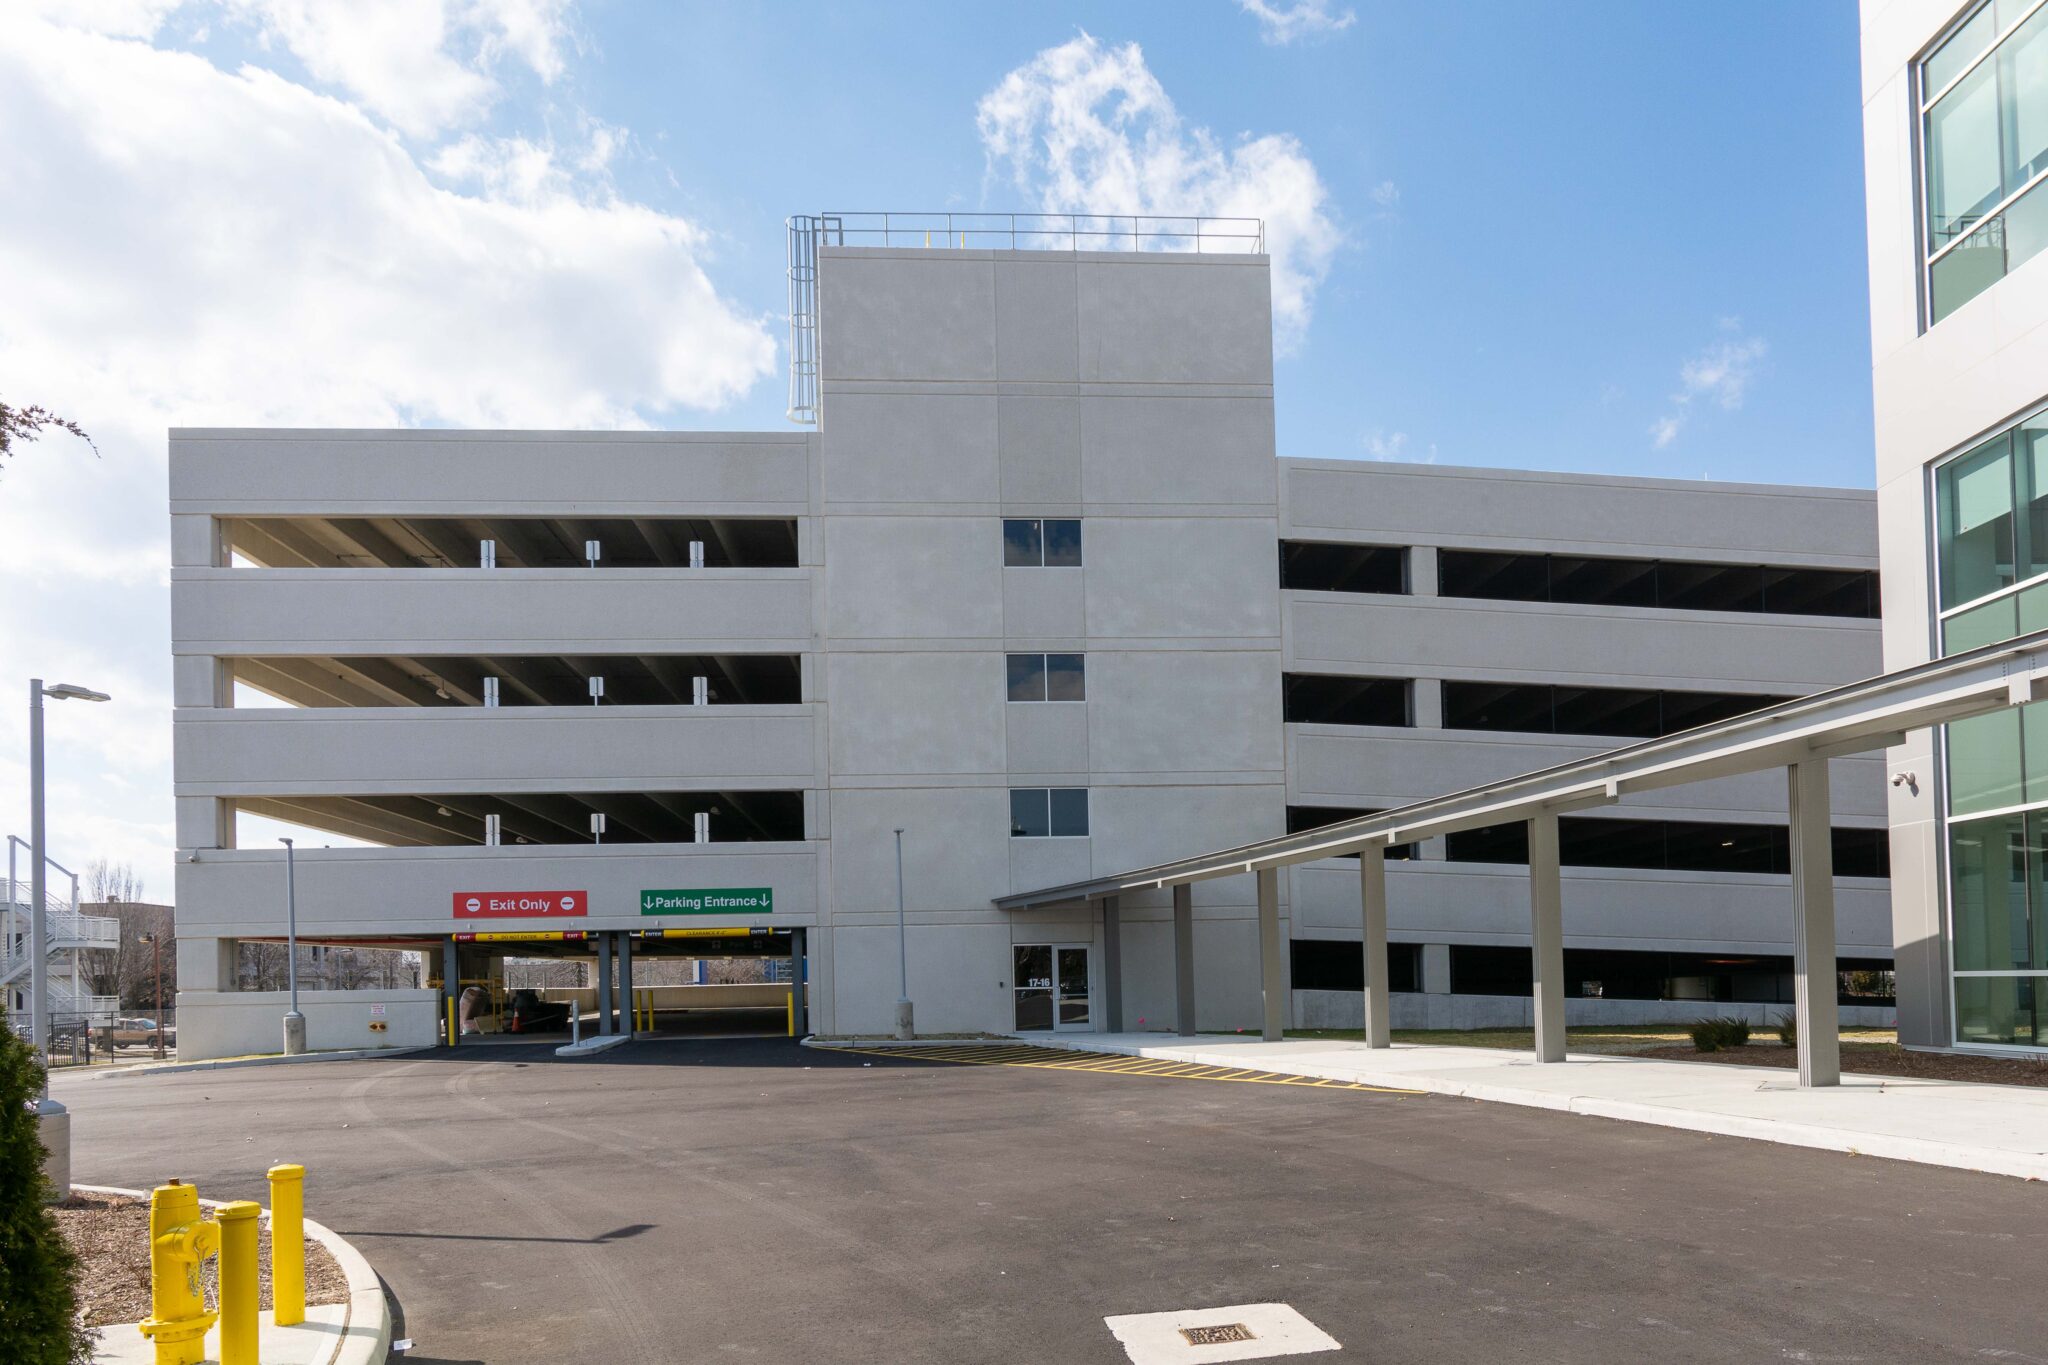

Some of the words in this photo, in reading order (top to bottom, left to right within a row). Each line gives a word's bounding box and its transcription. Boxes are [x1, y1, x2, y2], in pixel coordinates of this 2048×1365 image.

[489, 899, 516, 911] Exit
[519, 898, 550, 912] Only
[655, 896, 701, 910] Parking
[704, 896, 757, 907] Entrance
[1028, 977, 1050, 987] 17-16
